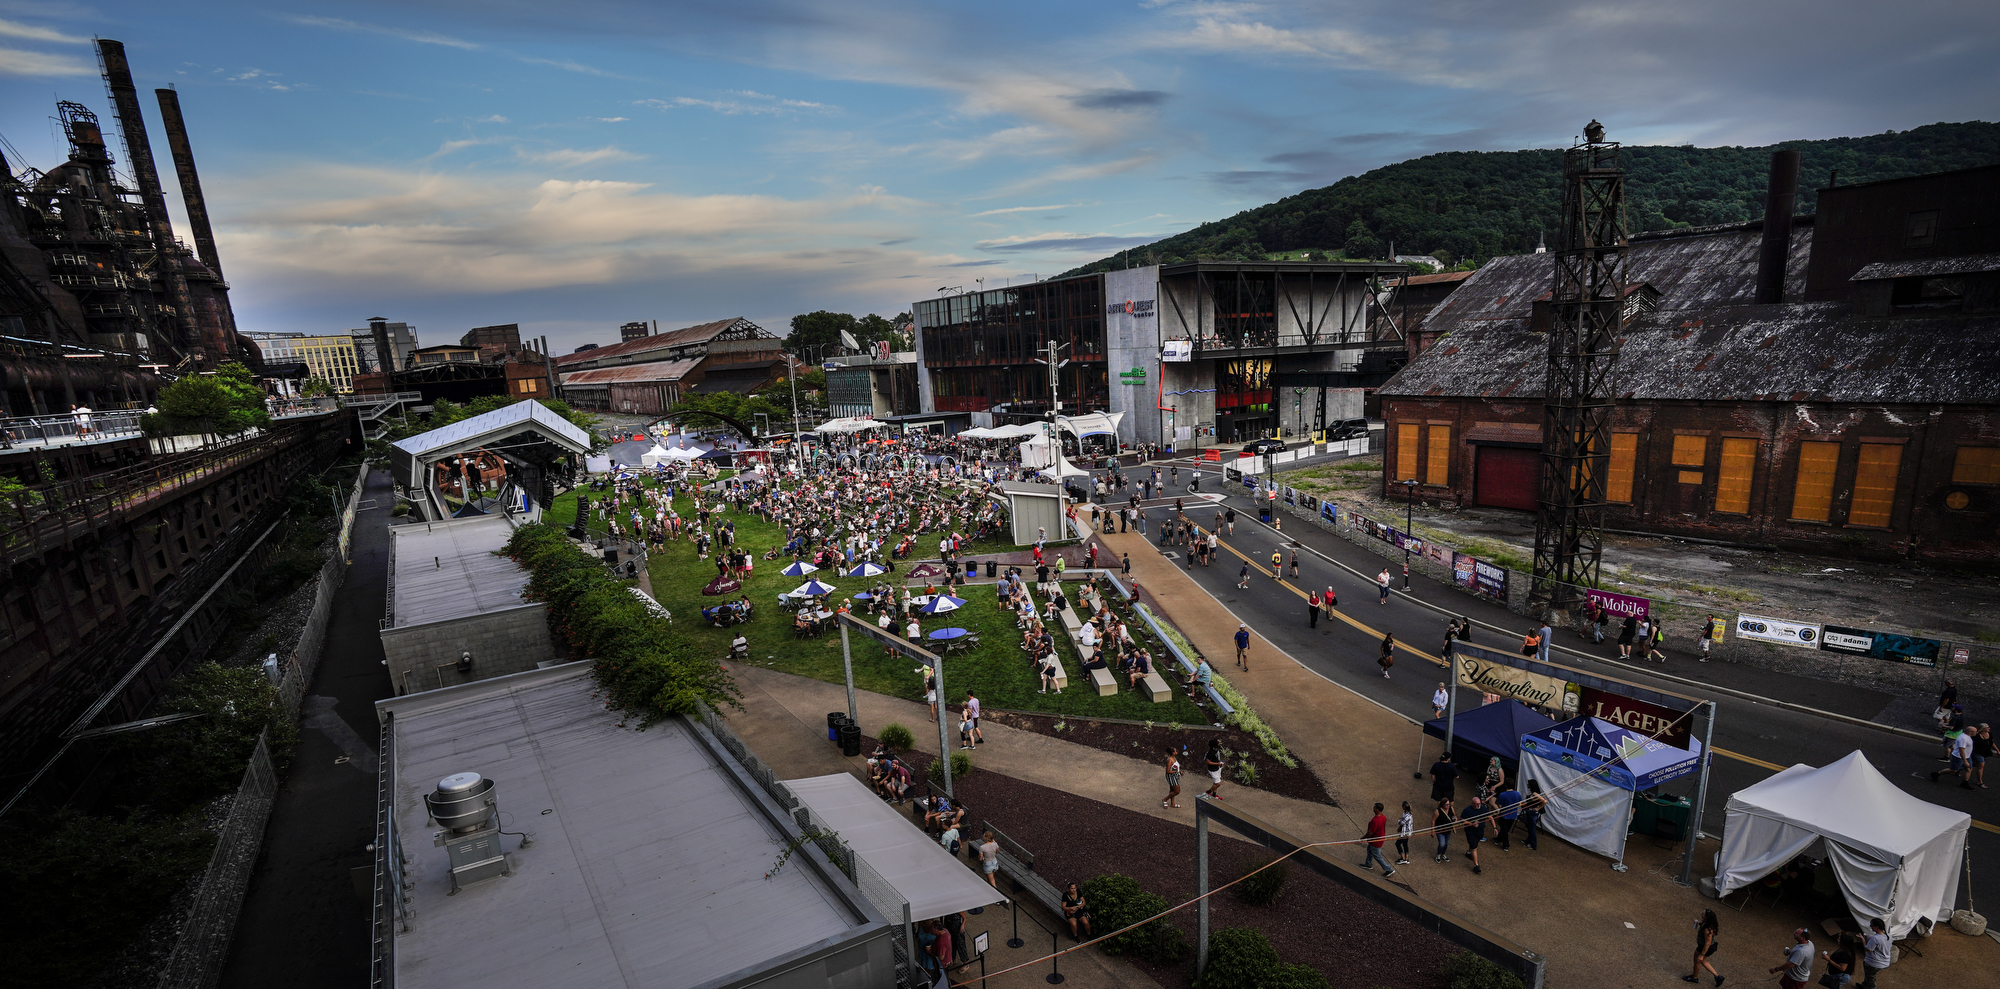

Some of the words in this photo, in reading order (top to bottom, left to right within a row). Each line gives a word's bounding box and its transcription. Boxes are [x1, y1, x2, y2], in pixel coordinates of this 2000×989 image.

[1108, 300, 1155, 315] ARTSQUEST
[1456, 570, 1470, 580] FEST
[1476, 562, 1504, 581] FIREWORKS
[1827, 644, 1865, 652] adamsoutdoor.com
[1843, 637, 1868, 646] adams
[1461, 660, 1556, 706] Yuengling
[1595, 701, 1674, 737] LAGER
[1648, 768, 1665, 779] CHOOSE
[1665, 761, 1687, 773] POLLUTION
[1687, 758, 1698, 766] FREE
[1654, 772, 1677, 784] ELECTRICITY
